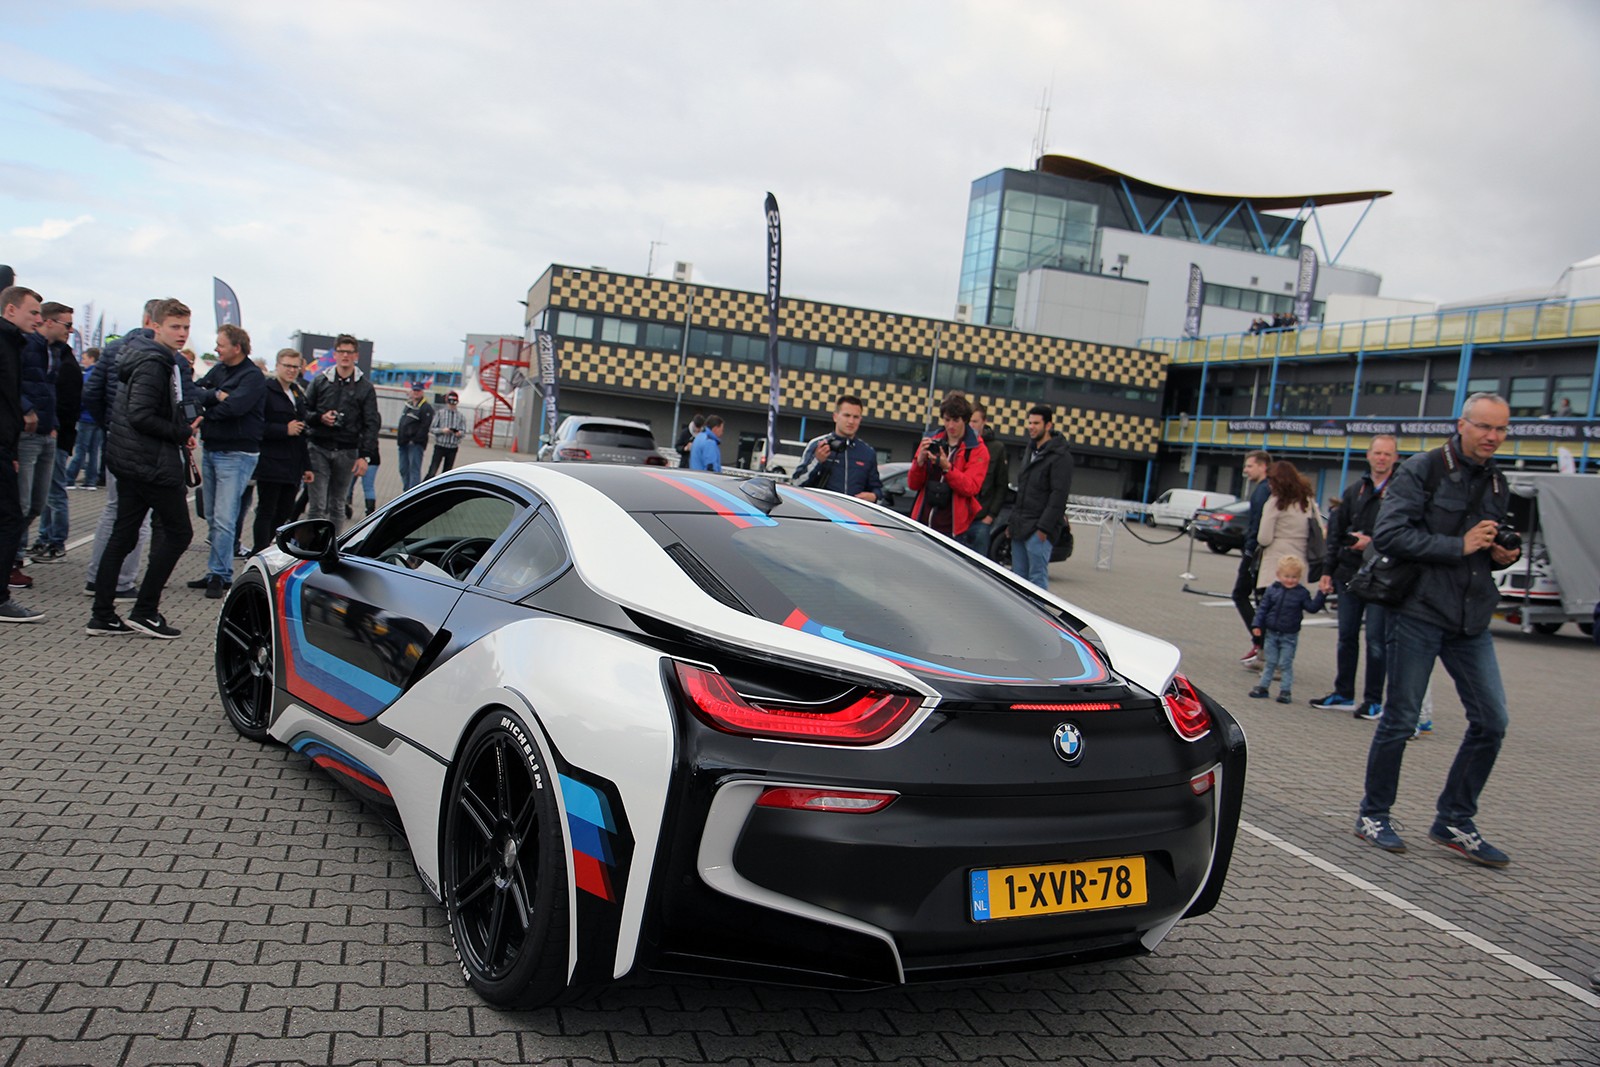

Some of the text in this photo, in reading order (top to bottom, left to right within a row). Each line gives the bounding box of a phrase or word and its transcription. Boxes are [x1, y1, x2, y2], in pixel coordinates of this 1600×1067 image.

[1269, 421, 1311, 432] VREDESTEIN
[1346, 422, 1396, 434] VREDESTEIN
[1400, 423, 1456, 434] VREDESTEIN
[1056, 724, 1080, 738] BMW
[500, 717, 543, 790] MICHELIN
[1005, 864, 1132, 910] 1-XVR-78
[973, 900, 988, 911] NL
